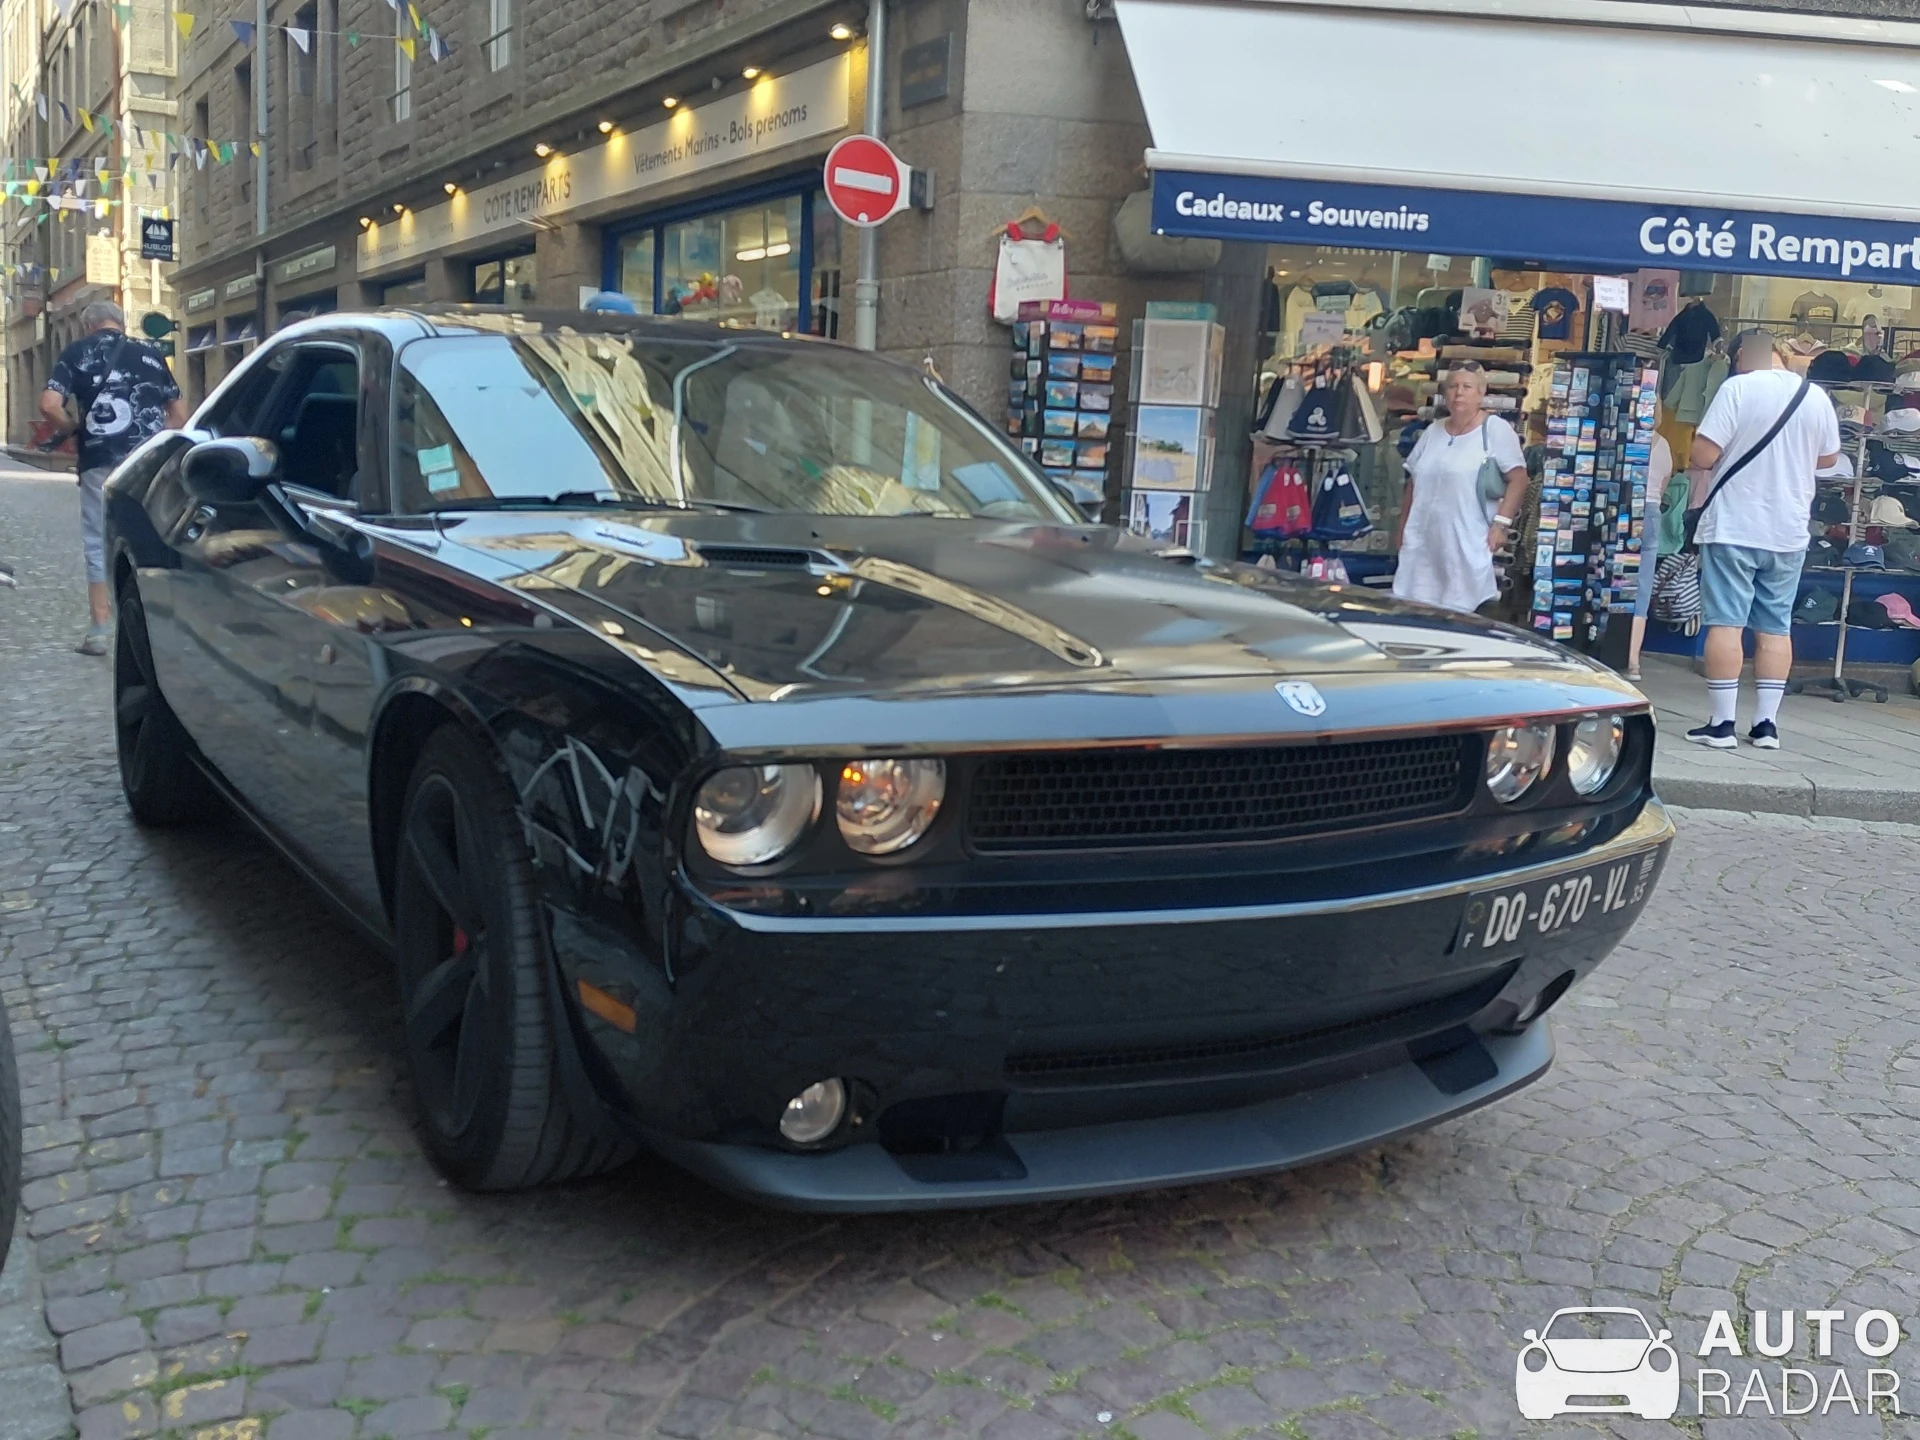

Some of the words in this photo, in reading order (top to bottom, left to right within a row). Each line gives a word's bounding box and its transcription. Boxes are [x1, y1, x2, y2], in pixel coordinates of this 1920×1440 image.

[634, 143, 682, 174] Vêtements
[685, 131, 719, 159] Marins
[729, 114, 753, 143] Bols
[755, 104, 807, 144] prénoms
[513, 170, 571, 214] REMPARTS
[1175, 191, 1283, 223] Cadeaux
[1307, 201, 1430, 232] Souvenirs
[1639, 216, 1737, 258] Côté
[1482, 863, 1630, 947] DQ-670-VL
